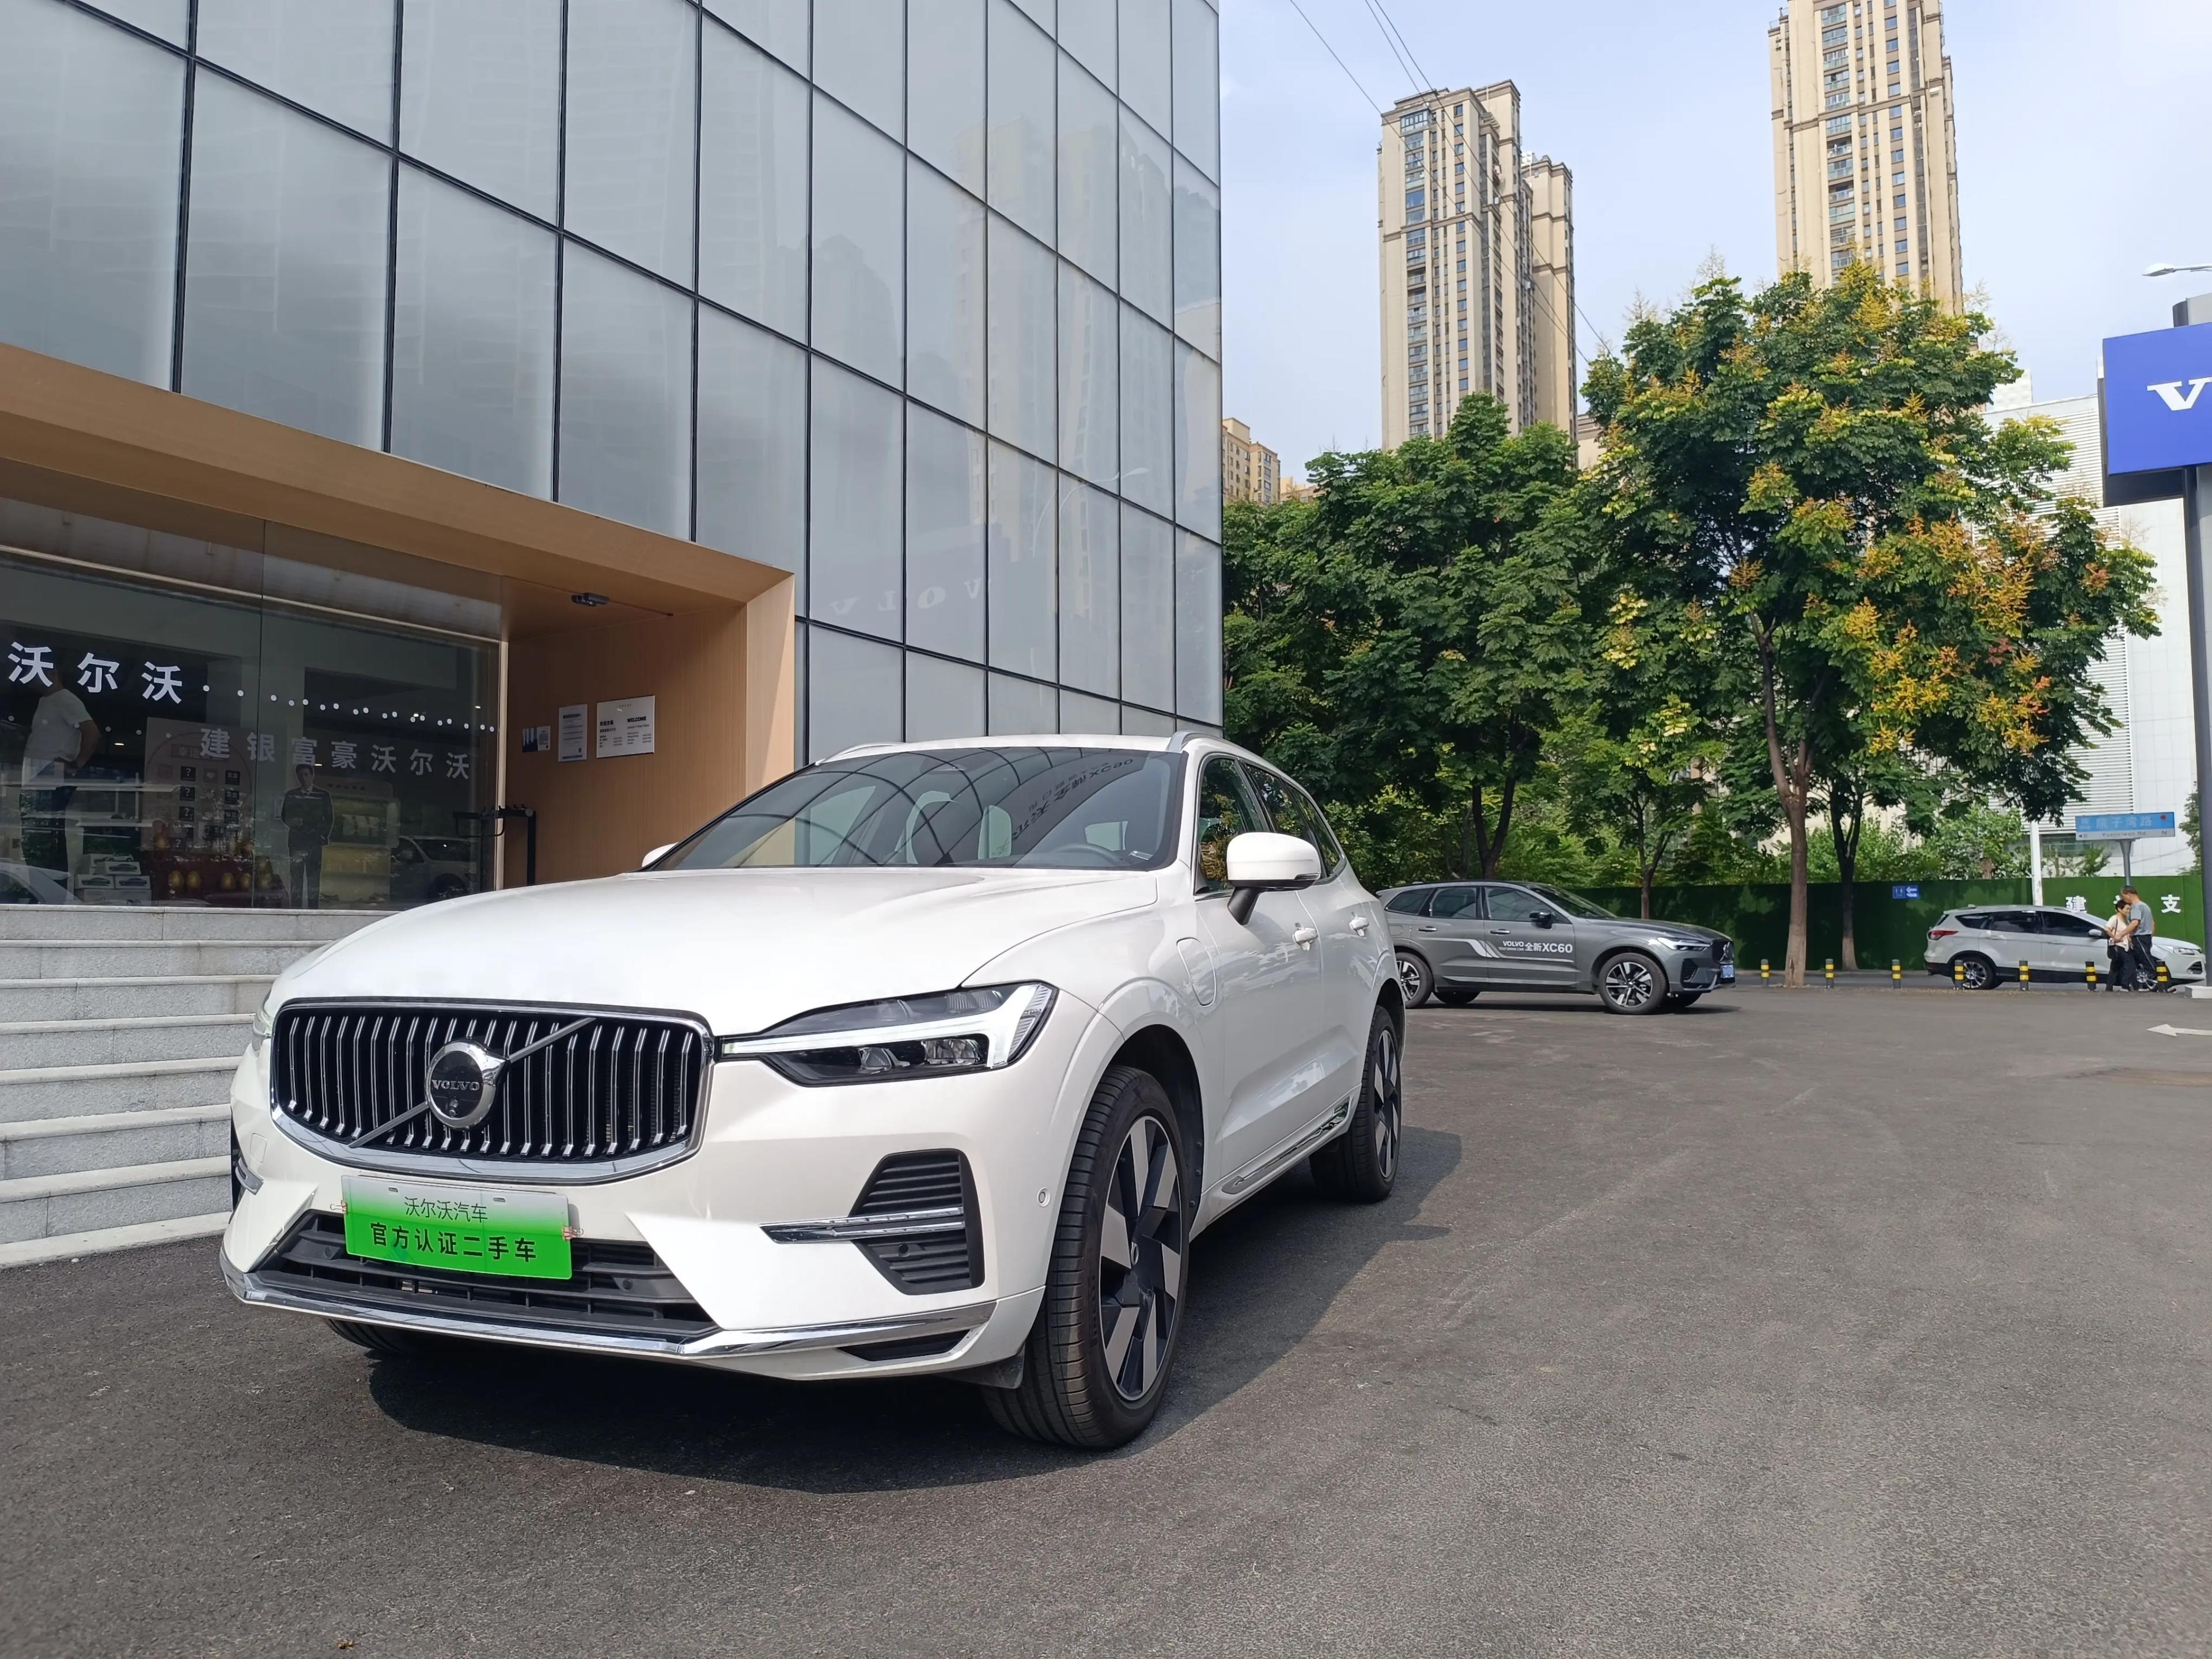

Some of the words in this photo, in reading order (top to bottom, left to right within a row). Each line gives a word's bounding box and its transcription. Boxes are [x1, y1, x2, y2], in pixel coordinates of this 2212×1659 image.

[8, 642, 183, 704] 沃尔沃
[200, 728, 470, 780] 建银富豪沃尔沃
[1525, 942, 1573, 953] 全新XC60
[431, 1080, 480, 1091] VOLVO
[404, 1196, 488, 1223] 沃尔沃汽车
[370, 1222, 536, 1263] 官方认证二手车
